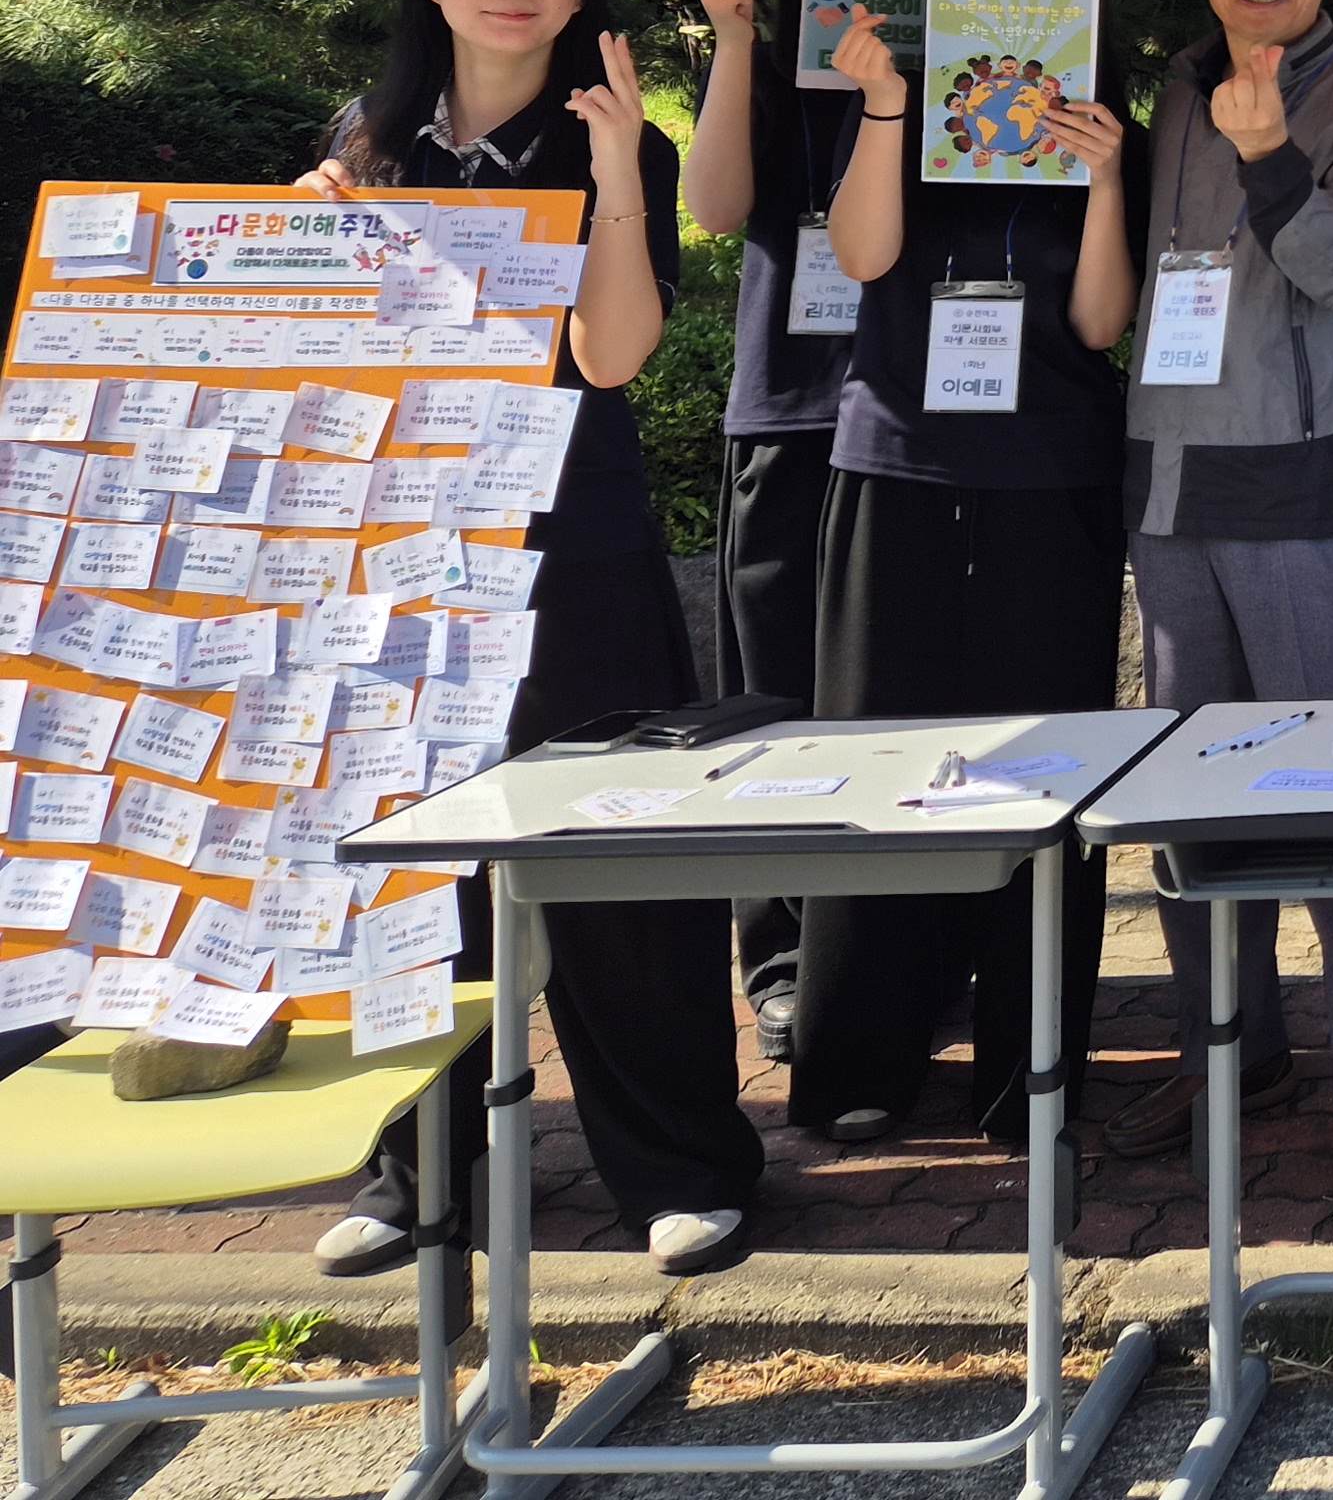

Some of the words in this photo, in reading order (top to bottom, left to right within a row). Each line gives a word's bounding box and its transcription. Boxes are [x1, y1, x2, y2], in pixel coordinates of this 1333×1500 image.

[961, 22, 989, 41] 우리는
[215, 213, 384, 239] 다문화이해주간
[80, 294, 118, 306] 다짐글
[124, 295, 135, 307] 중
[141, 295, 179, 307] 하나를
[184, 296, 235, 309] 선택하여
[241, 297, 279, 309] 자신의
[286, 297, 323, 310] 이름을
[329, 297, 369, 310] 작성한
[942, 378, 1002, 397] 이예림
